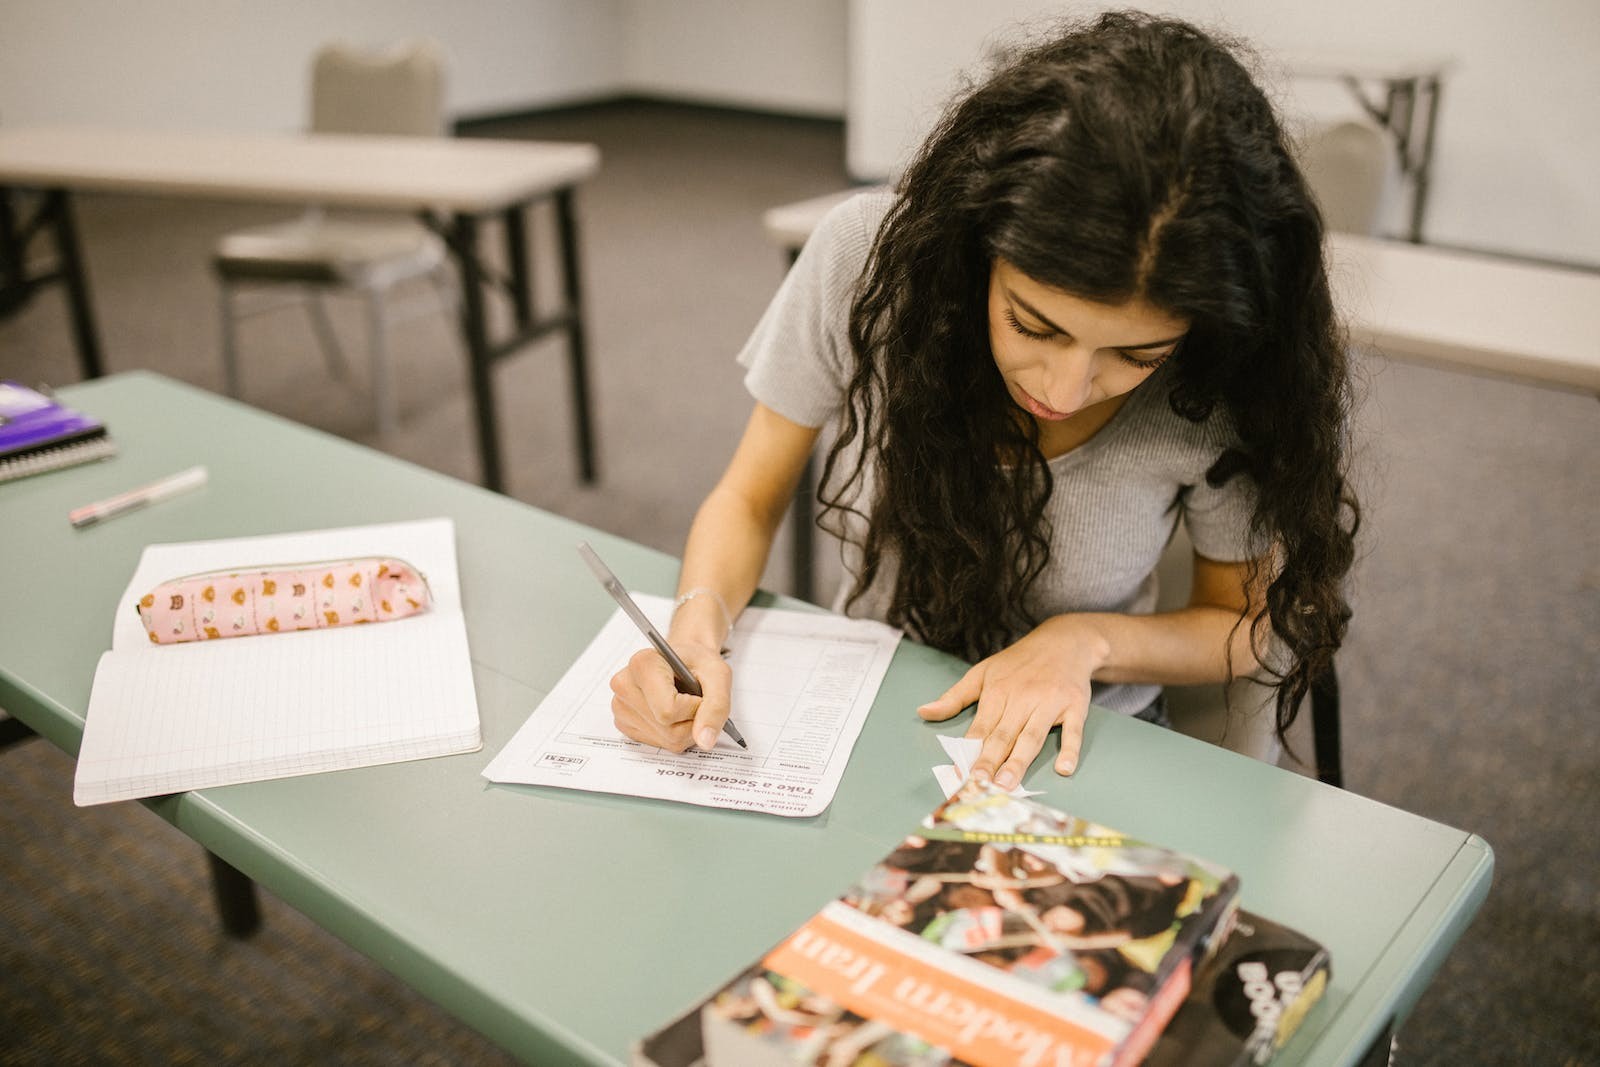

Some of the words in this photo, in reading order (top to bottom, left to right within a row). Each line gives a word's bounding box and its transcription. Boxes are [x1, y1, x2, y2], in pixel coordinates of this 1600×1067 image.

[655, 768, 695, 779] Look
[698, 774, 757, 788] Second
[776, 784, 814, 795] Take
[789, 929, 889, 996] Iran
